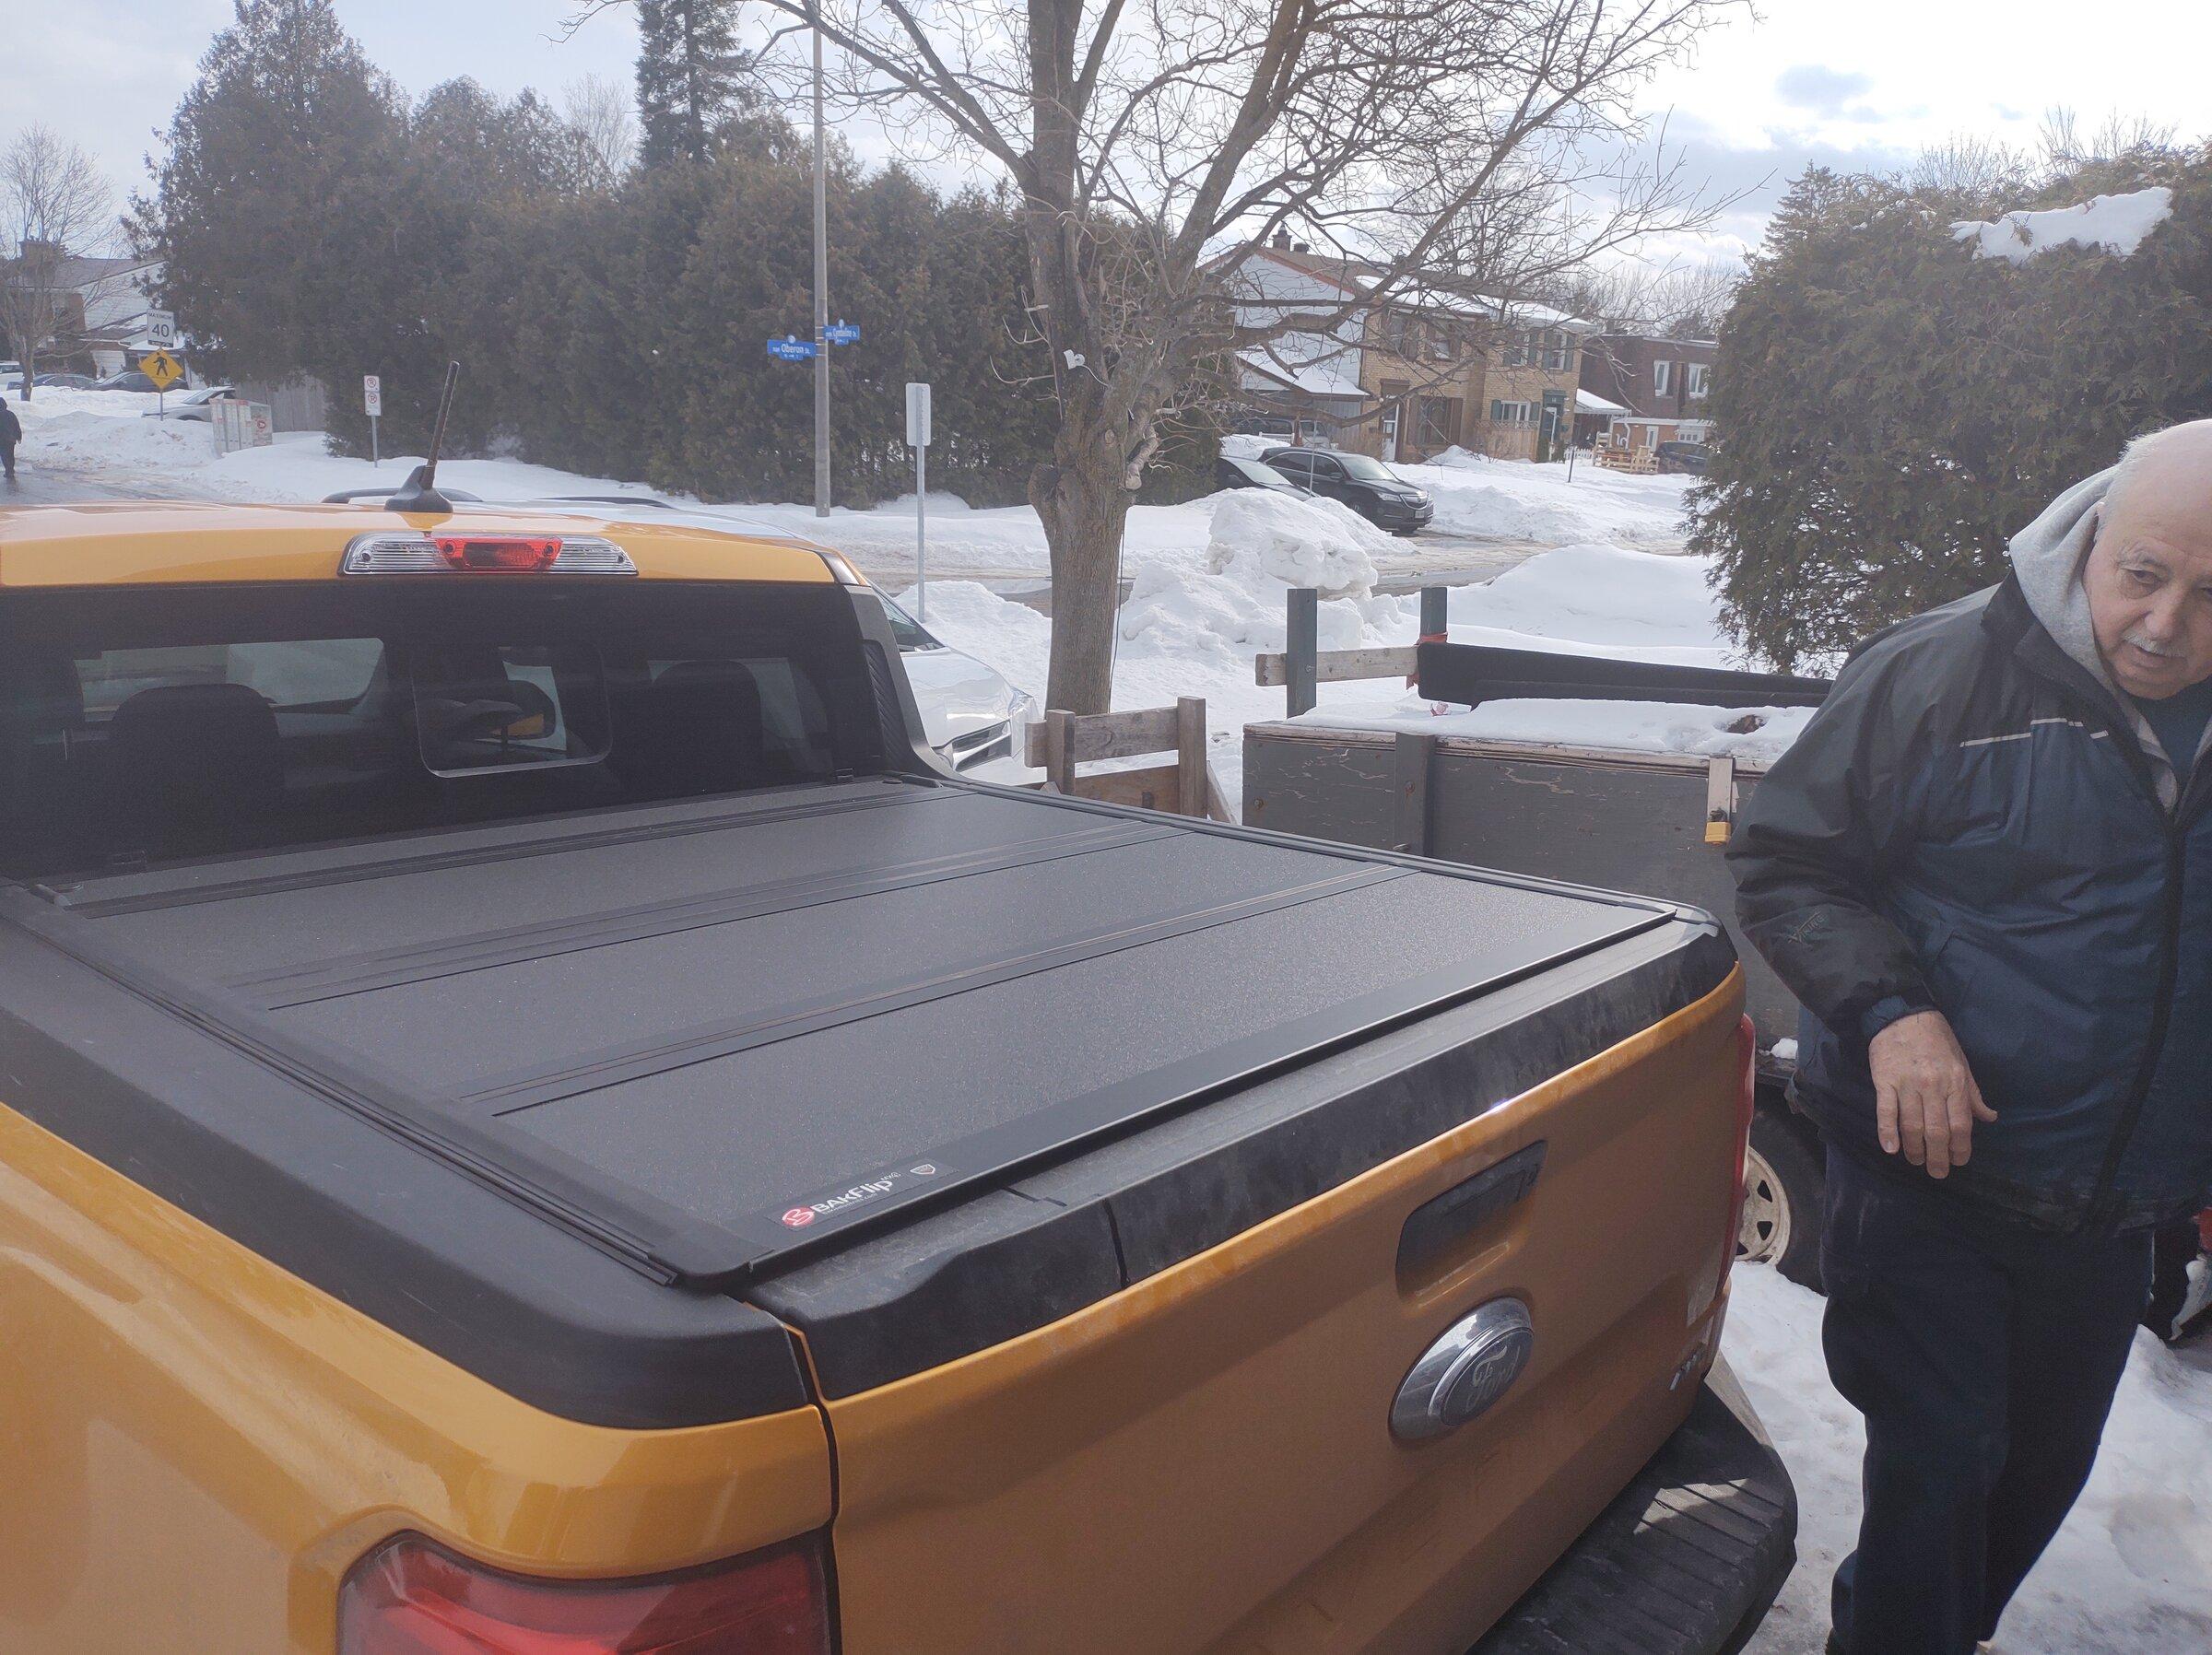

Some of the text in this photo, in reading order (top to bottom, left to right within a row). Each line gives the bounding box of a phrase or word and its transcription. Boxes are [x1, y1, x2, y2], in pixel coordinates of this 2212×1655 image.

[152, 323, 170, 337] 40
[782, 343, 804, 354] Oberon
[810, 1180, 892, 1214] BAKFlip
